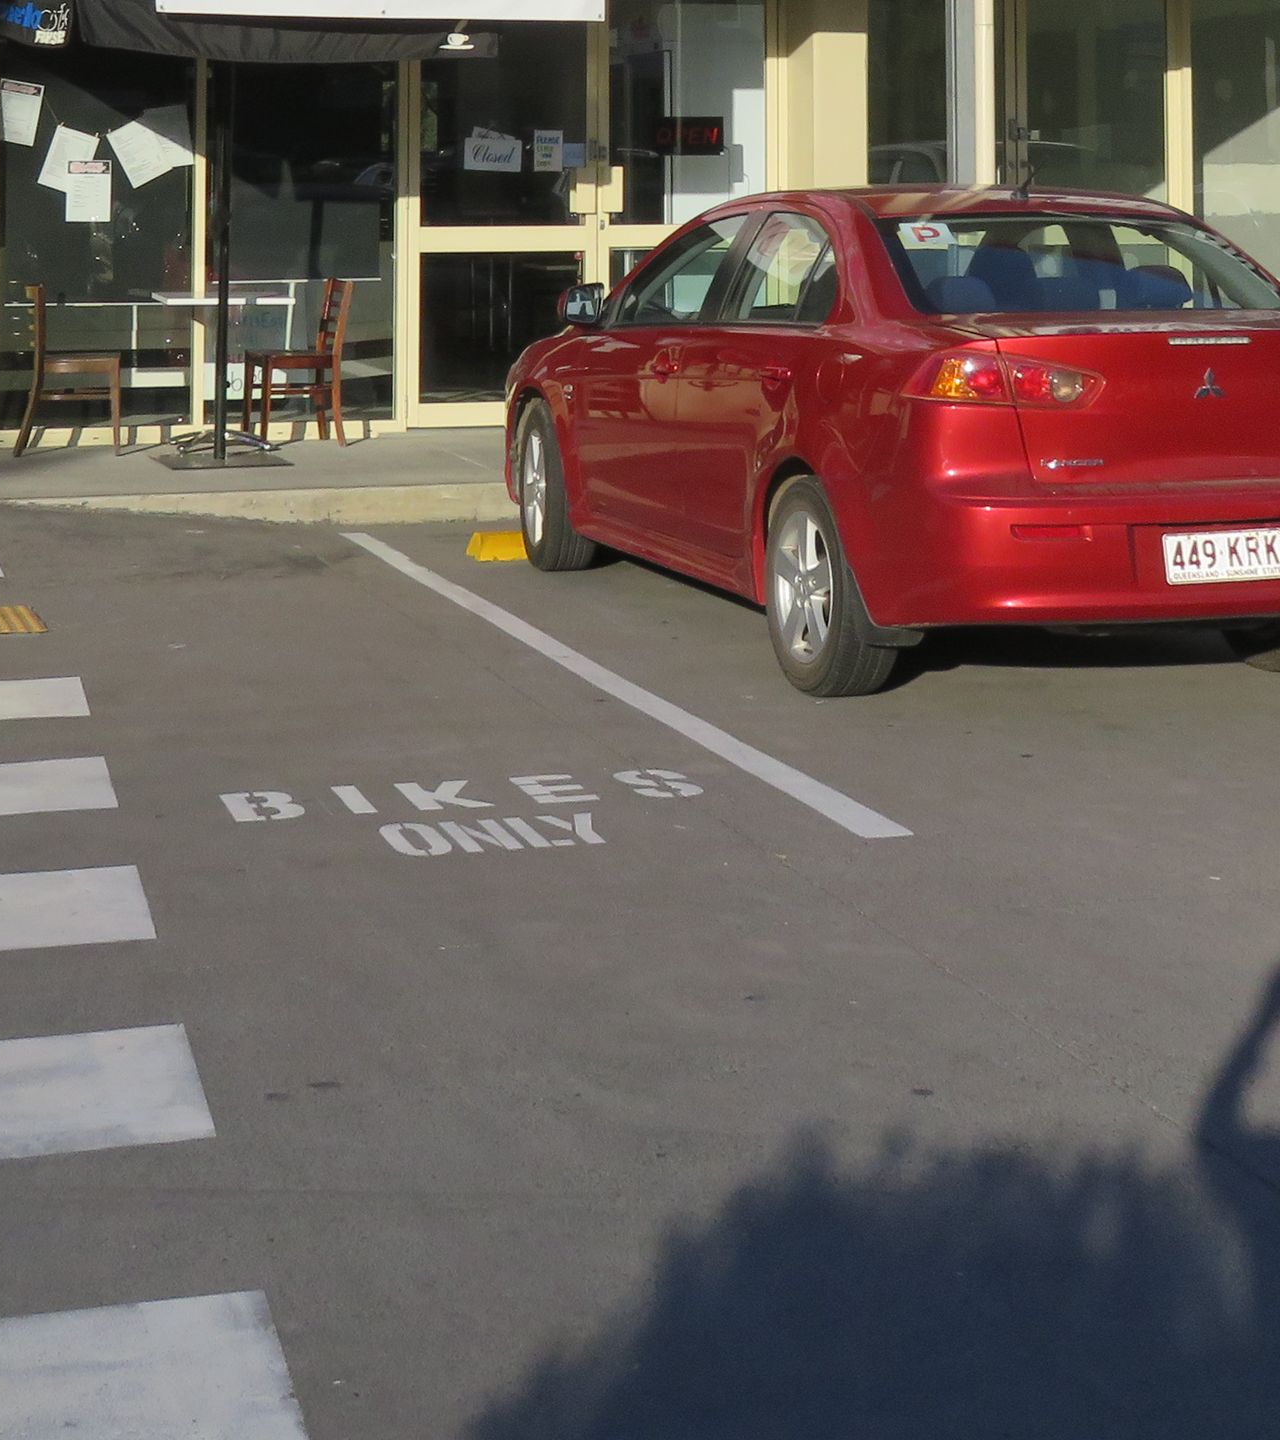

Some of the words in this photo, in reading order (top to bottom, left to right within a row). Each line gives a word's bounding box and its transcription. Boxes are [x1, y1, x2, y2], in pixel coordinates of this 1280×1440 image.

[472, 144, 516, 164] Closed
[912, 226, 940, 242] P
[1173, 570, 1219, 580] QUEENSLAND
[219, 768, 704, 823] BIKES
[379, 812, 607, 856] ONLY
